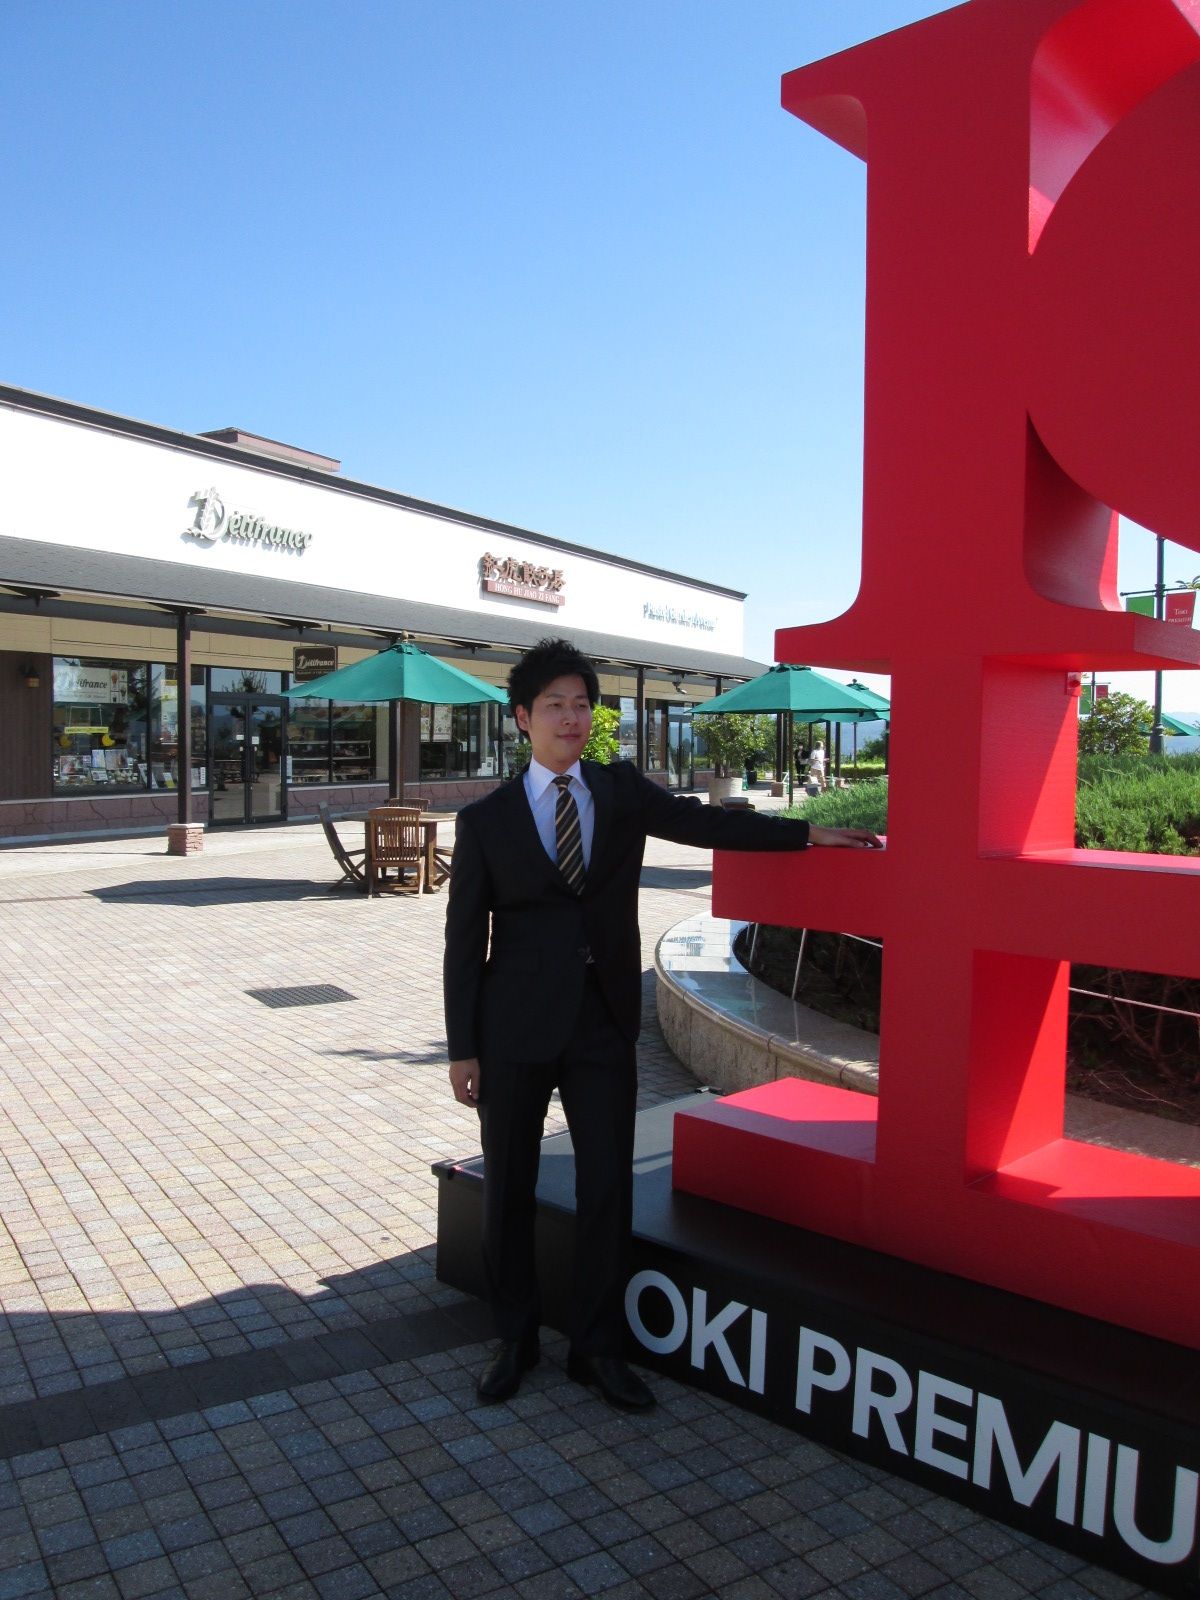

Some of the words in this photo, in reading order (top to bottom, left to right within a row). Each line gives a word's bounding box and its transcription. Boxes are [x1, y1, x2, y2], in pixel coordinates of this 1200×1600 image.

[495, 583, 513, 593] HONG
[513, 586, 523, 596] HU
[546, 593, 561, 604] FANG
[795, 1326, 1200, 1564] PREMIU
